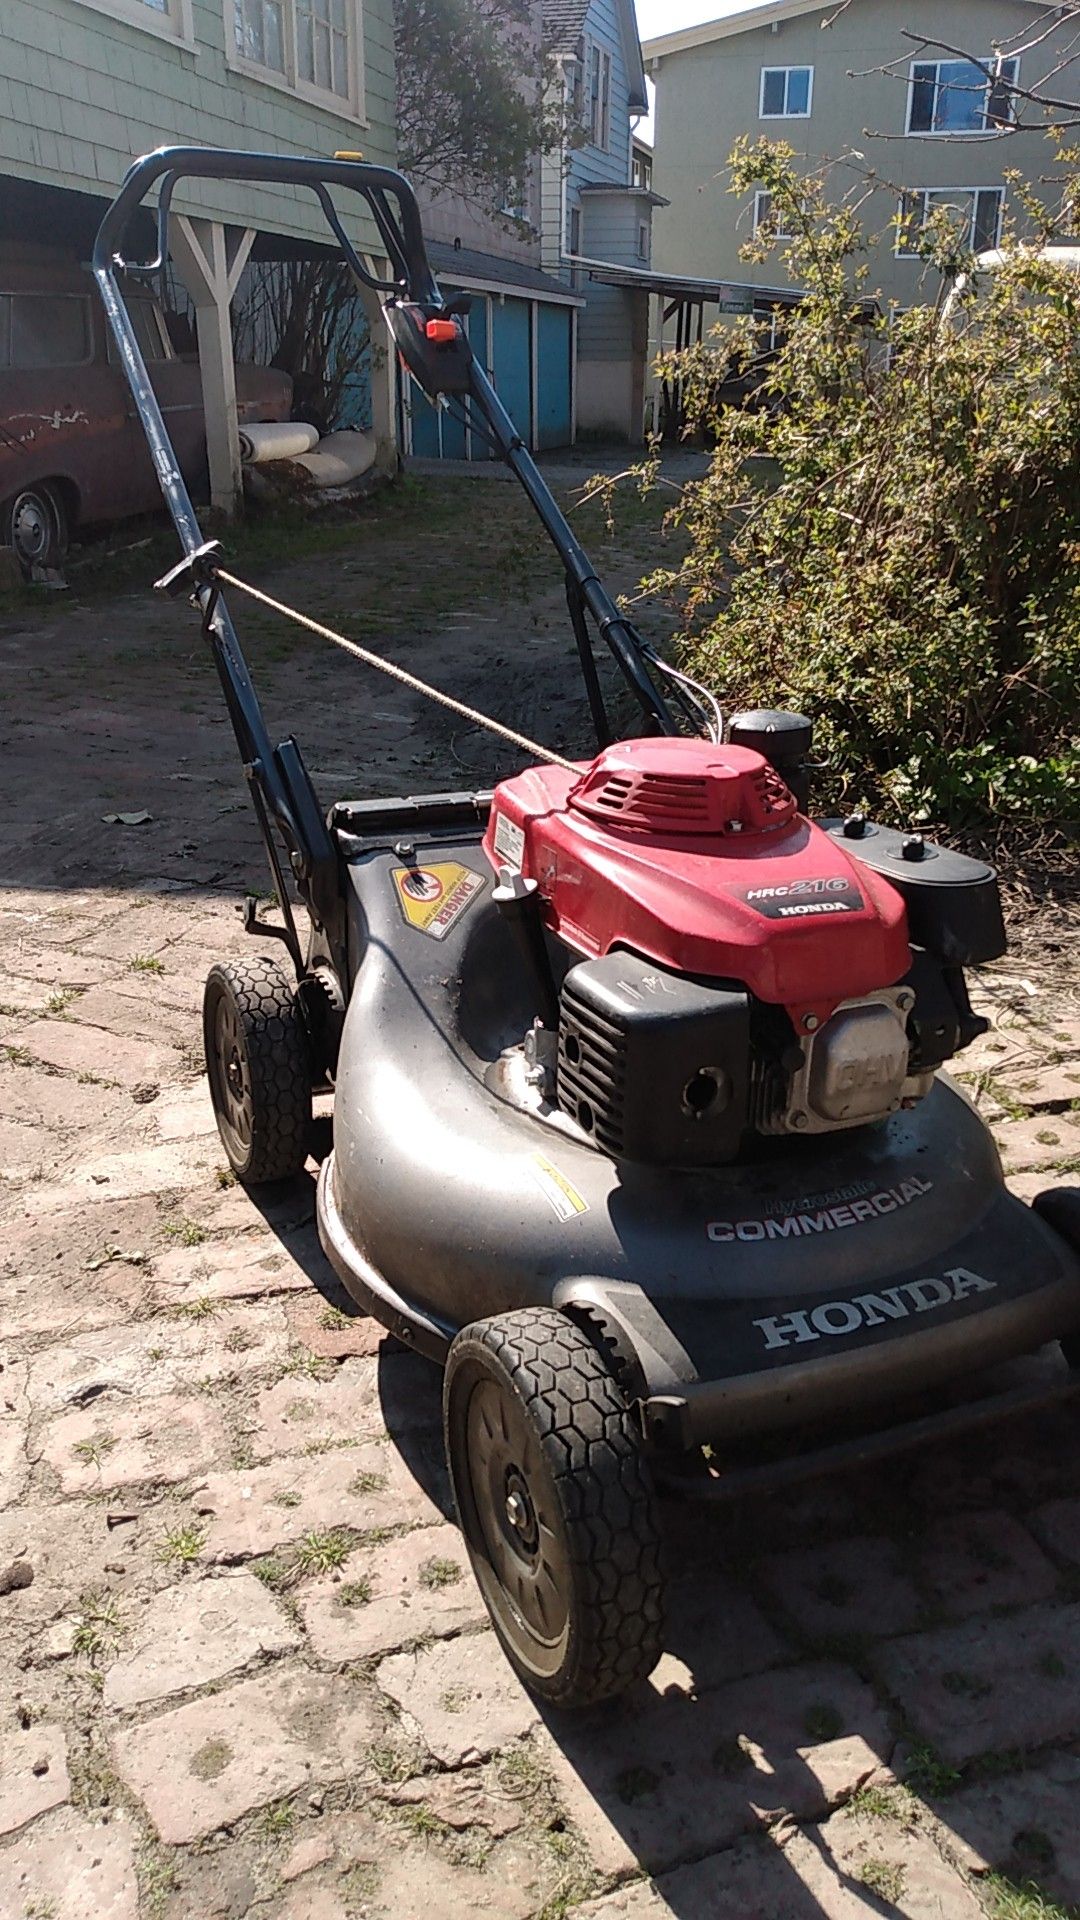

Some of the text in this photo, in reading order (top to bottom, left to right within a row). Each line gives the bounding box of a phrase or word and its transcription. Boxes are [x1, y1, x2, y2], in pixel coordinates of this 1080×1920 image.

[435, 882, 474, 926] DANGER
[747, 878, 849, 899] HRC216
[778, 902, 849, 915] HONDA
[707, 1176, 934, 1242] COMMERCIAL
[752, 1268, 997, 1349] HONDA
